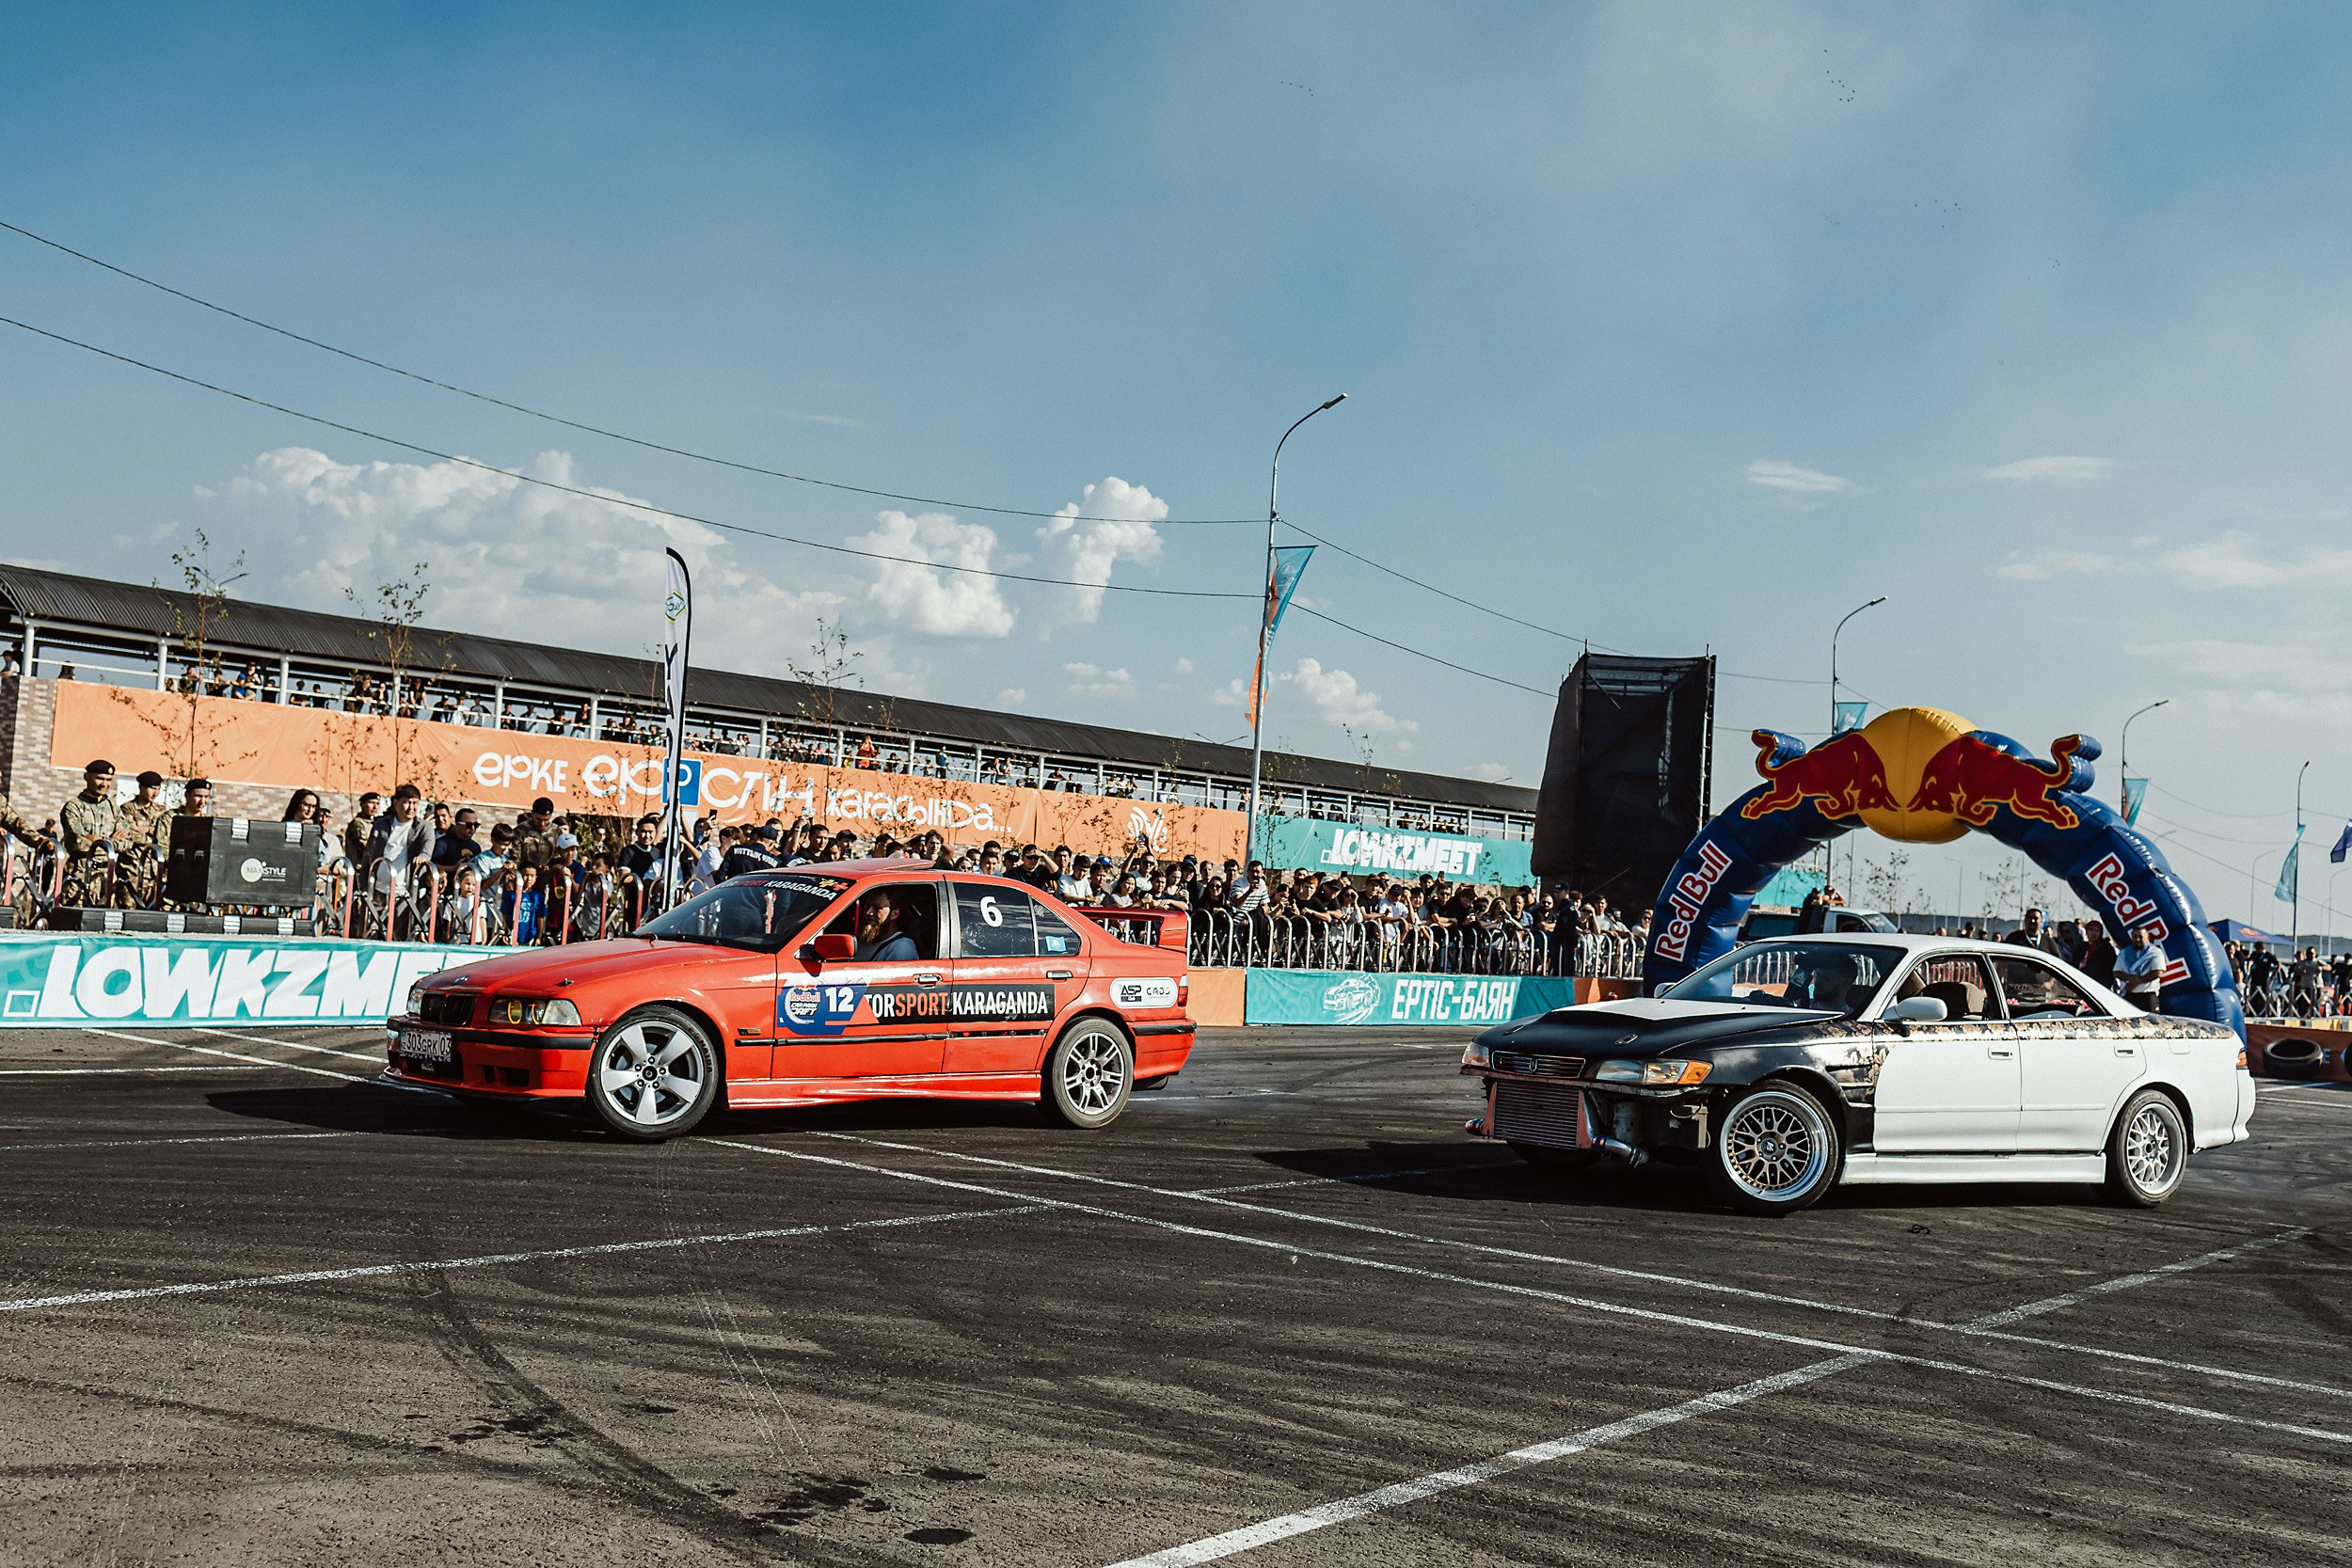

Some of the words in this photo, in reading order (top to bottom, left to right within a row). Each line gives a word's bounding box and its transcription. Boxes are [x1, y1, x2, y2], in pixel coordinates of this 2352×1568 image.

[763, 879, 837, 900] KARAGANDA
[1654, 894, 1700, 961] Red
[1677, 839, 1733, 905] Bull
[2084, 851, 2157, 927] Red
[979, 895, 1003, 927] 6
[825, 987, 854, 1012] 12
[952, 990, 1049, 1016] KARAGANDA
